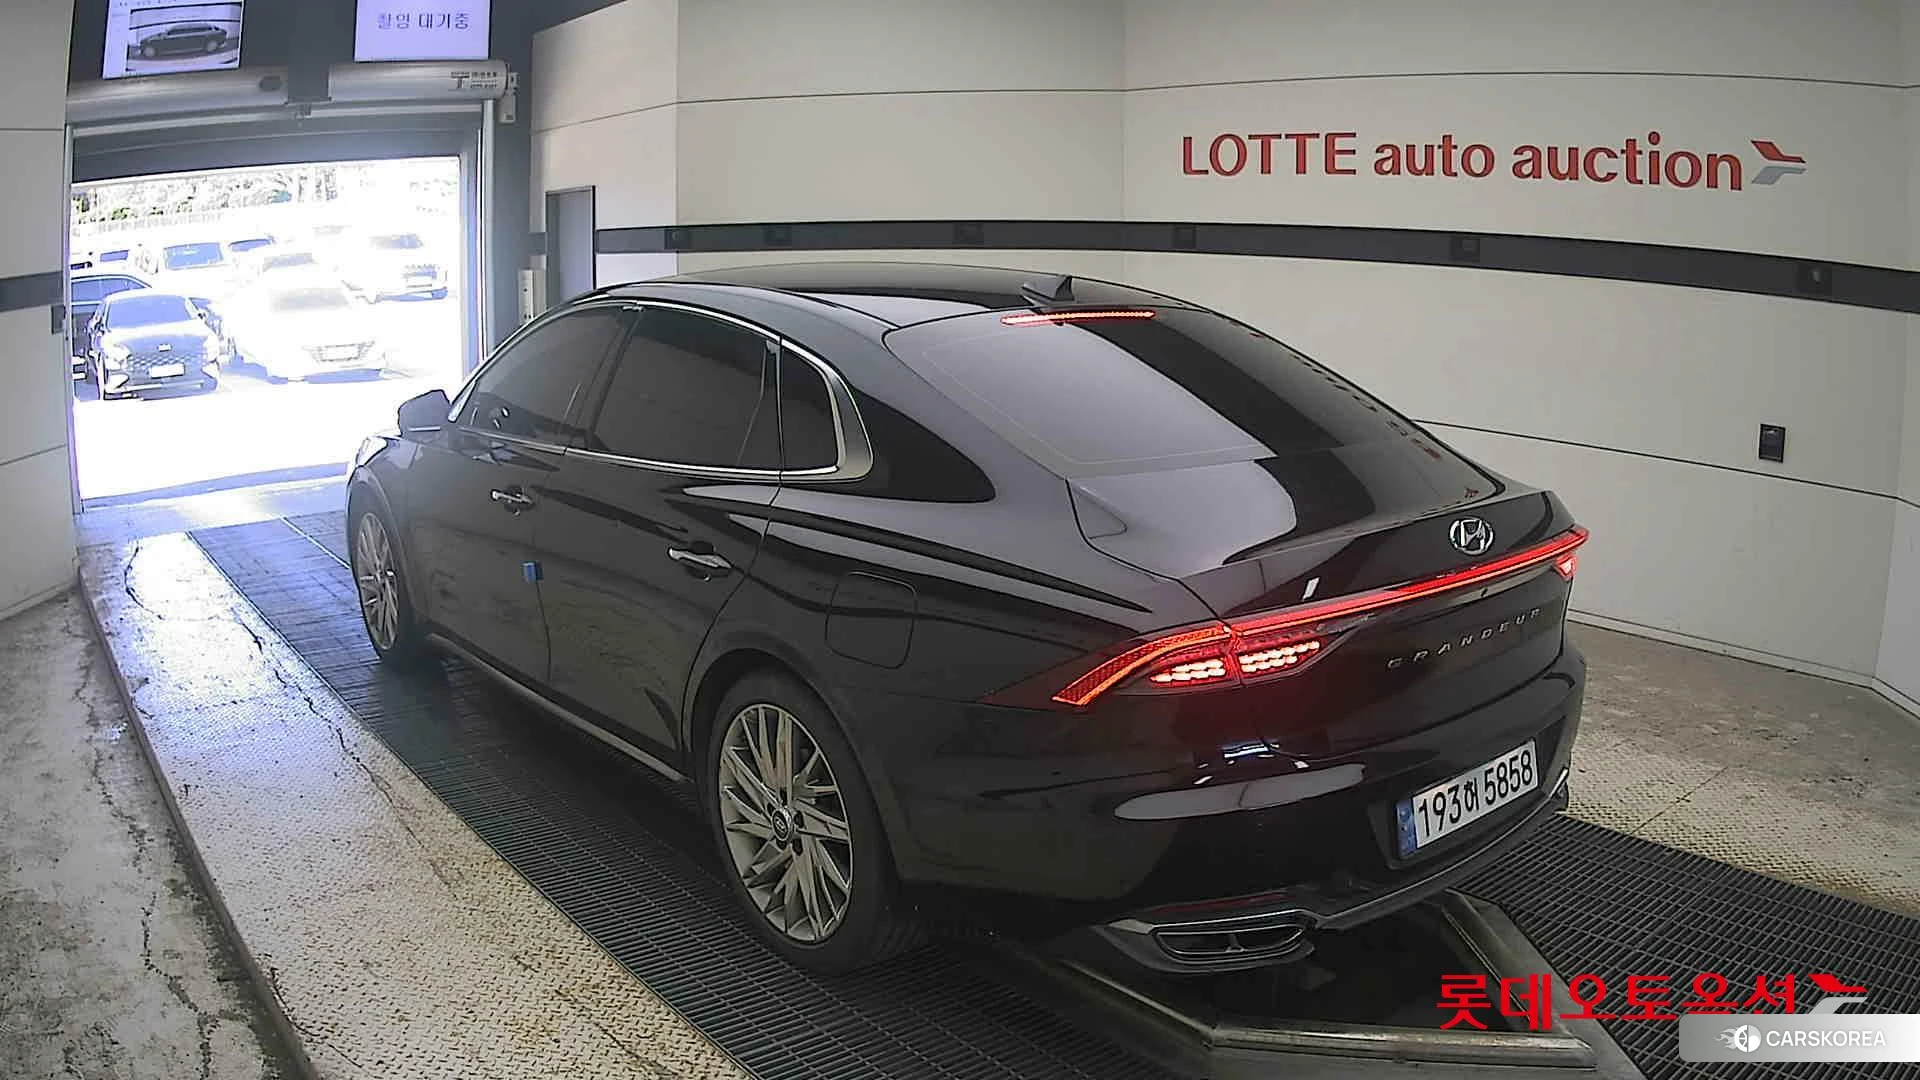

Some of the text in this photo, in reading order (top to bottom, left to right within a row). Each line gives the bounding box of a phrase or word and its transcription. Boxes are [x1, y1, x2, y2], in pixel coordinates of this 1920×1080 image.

[418, 12, 469, 30] 대기중
[1182, 131, 1743, 191] LOTTE auto auction
[1387, 608, 1540, 669] GRANDEUR
[1483, 750, 1533, 806] 5858
